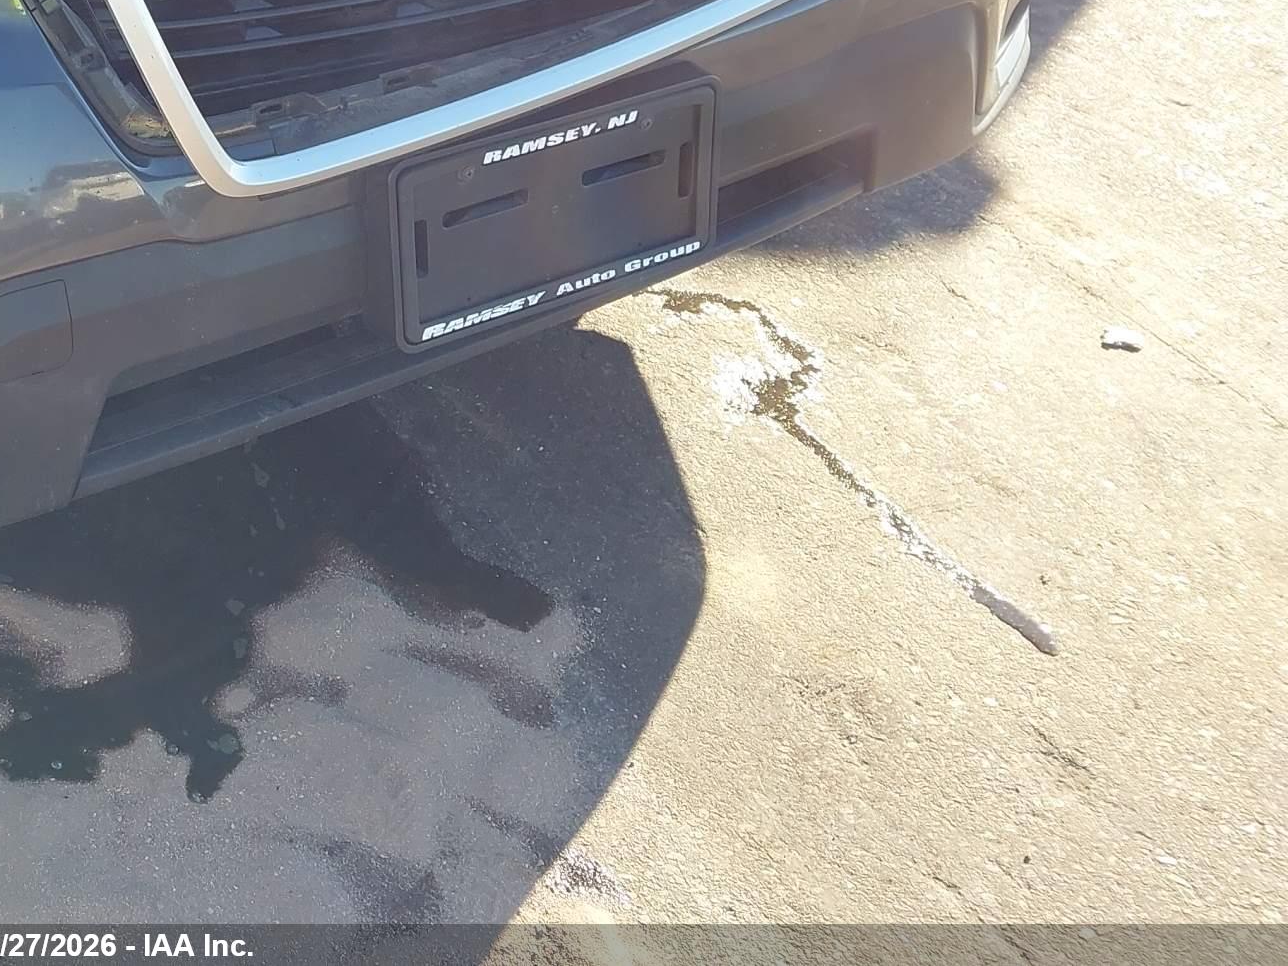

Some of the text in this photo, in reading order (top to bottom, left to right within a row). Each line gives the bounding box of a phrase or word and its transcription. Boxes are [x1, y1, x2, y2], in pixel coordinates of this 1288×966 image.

[607, 110, 638, 130] NJ
[421, 241, 701, 341] RAMSEY Auto Group
